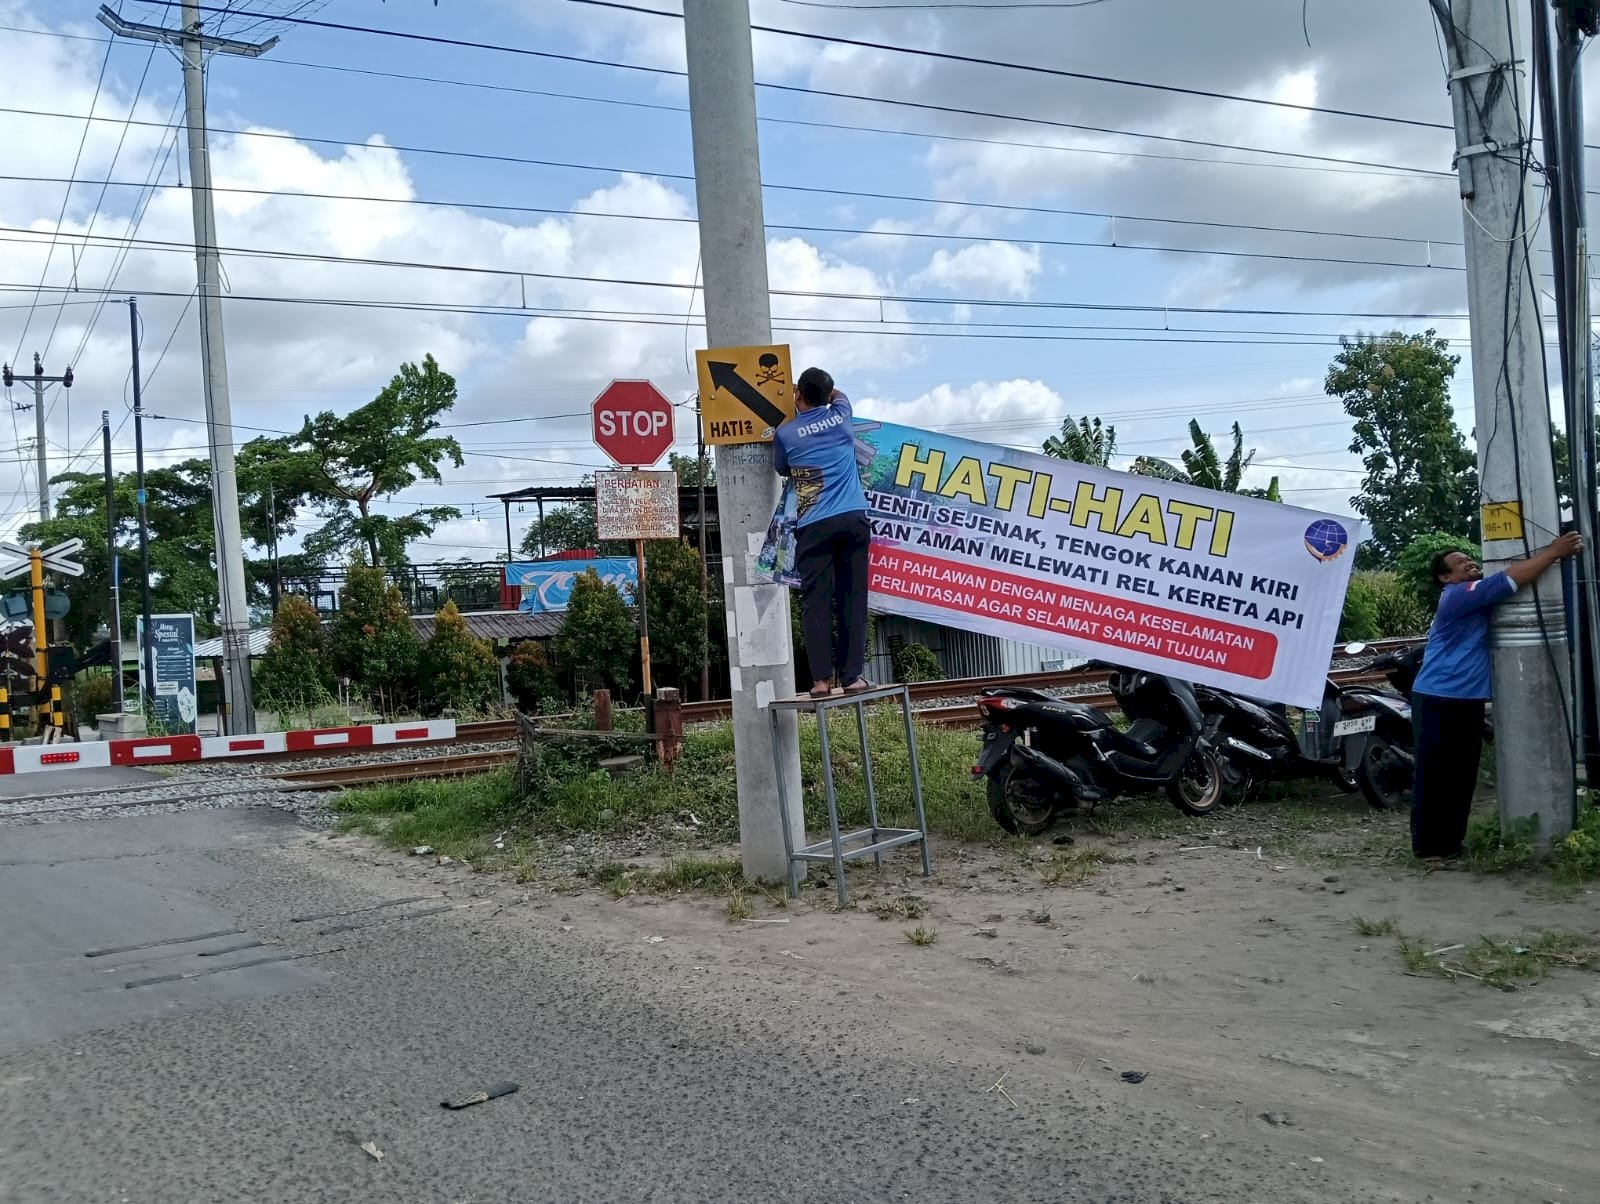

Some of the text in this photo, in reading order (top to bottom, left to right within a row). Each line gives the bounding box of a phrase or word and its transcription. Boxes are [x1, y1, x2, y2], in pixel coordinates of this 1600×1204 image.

[599, 410, 668, 437] STOP
[797, 414, 844, 438] DISHUB
[894, 442, 1236, 559] HATI-HATI
[916, 530, 985, 557] AMAN
[990, 545, 1109, 586] MELEWATI
[1116, 574, 1160, 597] REL
[1167, 585, 1259, 620] KERETA
[1265, 607, 1304, 630] API
[936, 508, 1047, 550] SEJENAK,
[1055, 534, 1153, 569] TENGOK
[1158, 556, 1244, 589] KANAN
[1250, 575, 1299, 601] KIRI
[871, 574, 1228, 665] PERLINTASAN AGAR SELAMAT SAMPAI TUJUAN
[902, 560, 987, 590] PAHLAWAN
[990, 579, 1057, 605] DENGAN
[1060, 594, 1136, 624] MENJAGA
[1139, 613, 1255, 651] KESELAMATAN
